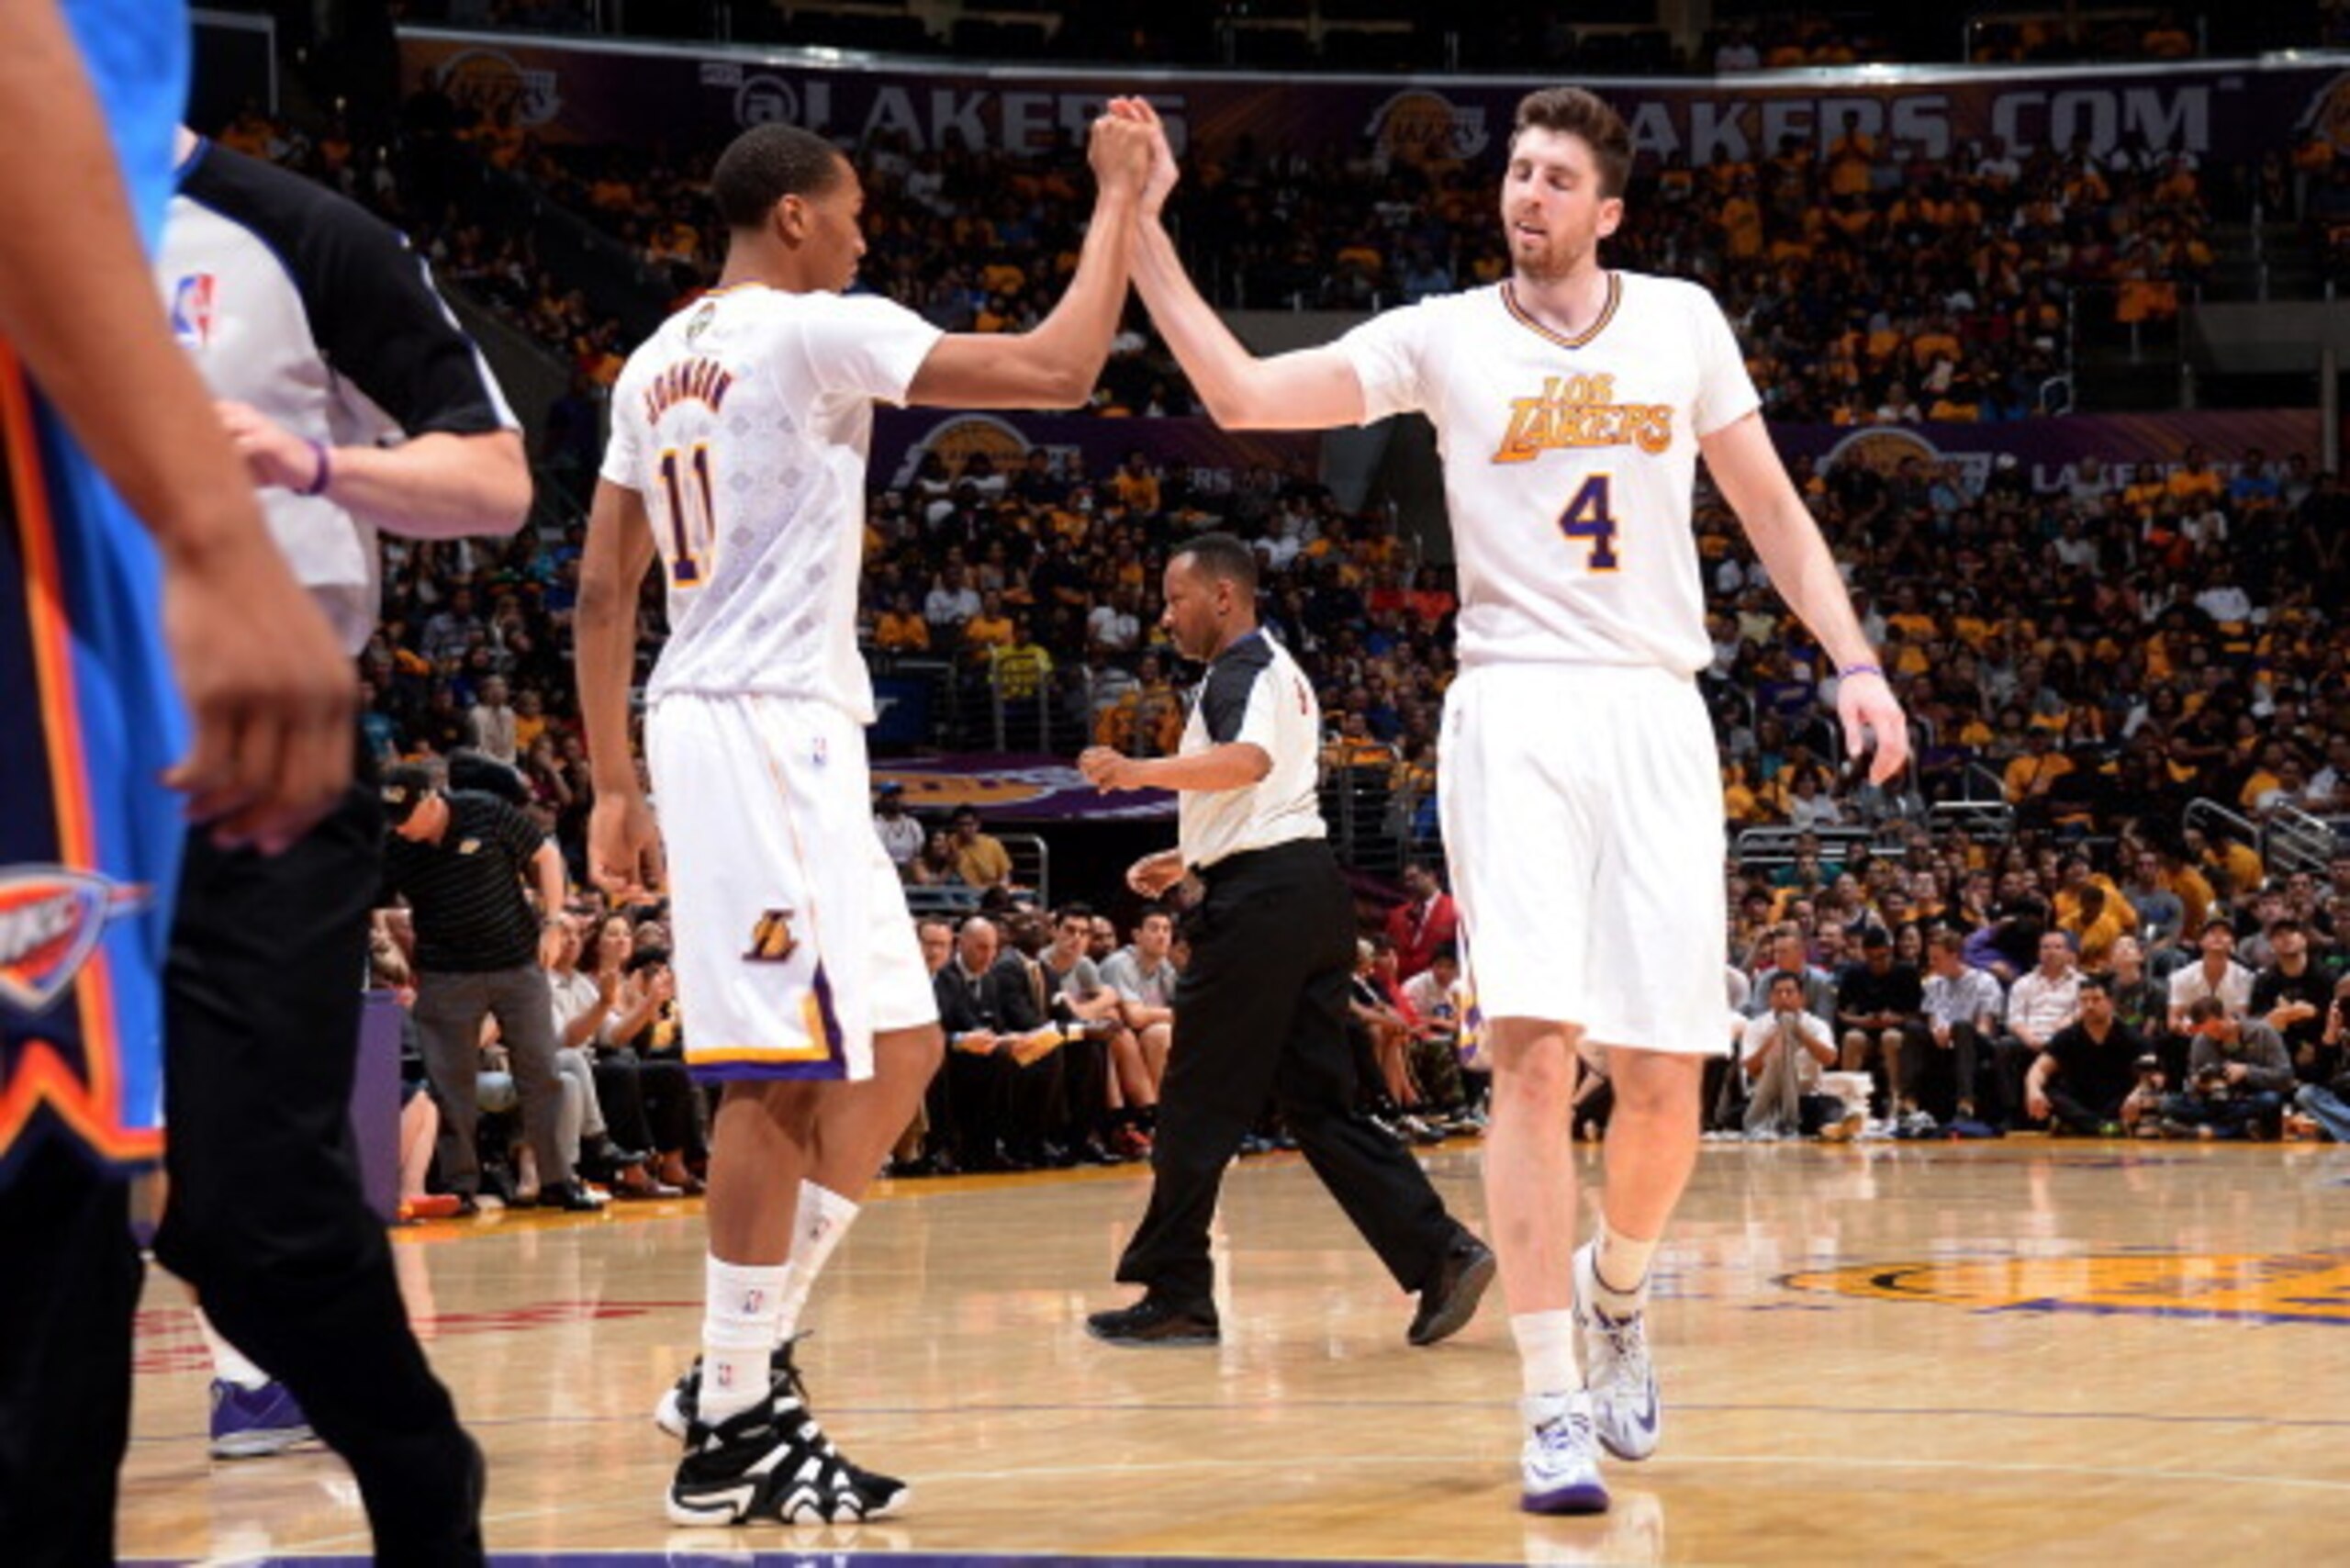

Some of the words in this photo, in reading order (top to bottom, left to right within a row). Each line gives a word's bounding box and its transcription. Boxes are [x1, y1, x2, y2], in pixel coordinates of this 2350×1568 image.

[1491, 397, 1673, 464] LAKERS
[1545, 373, 1615, 407] LOS
[657, 442, 716, 587] 11
[1558, 472, 1620, 573] 4
